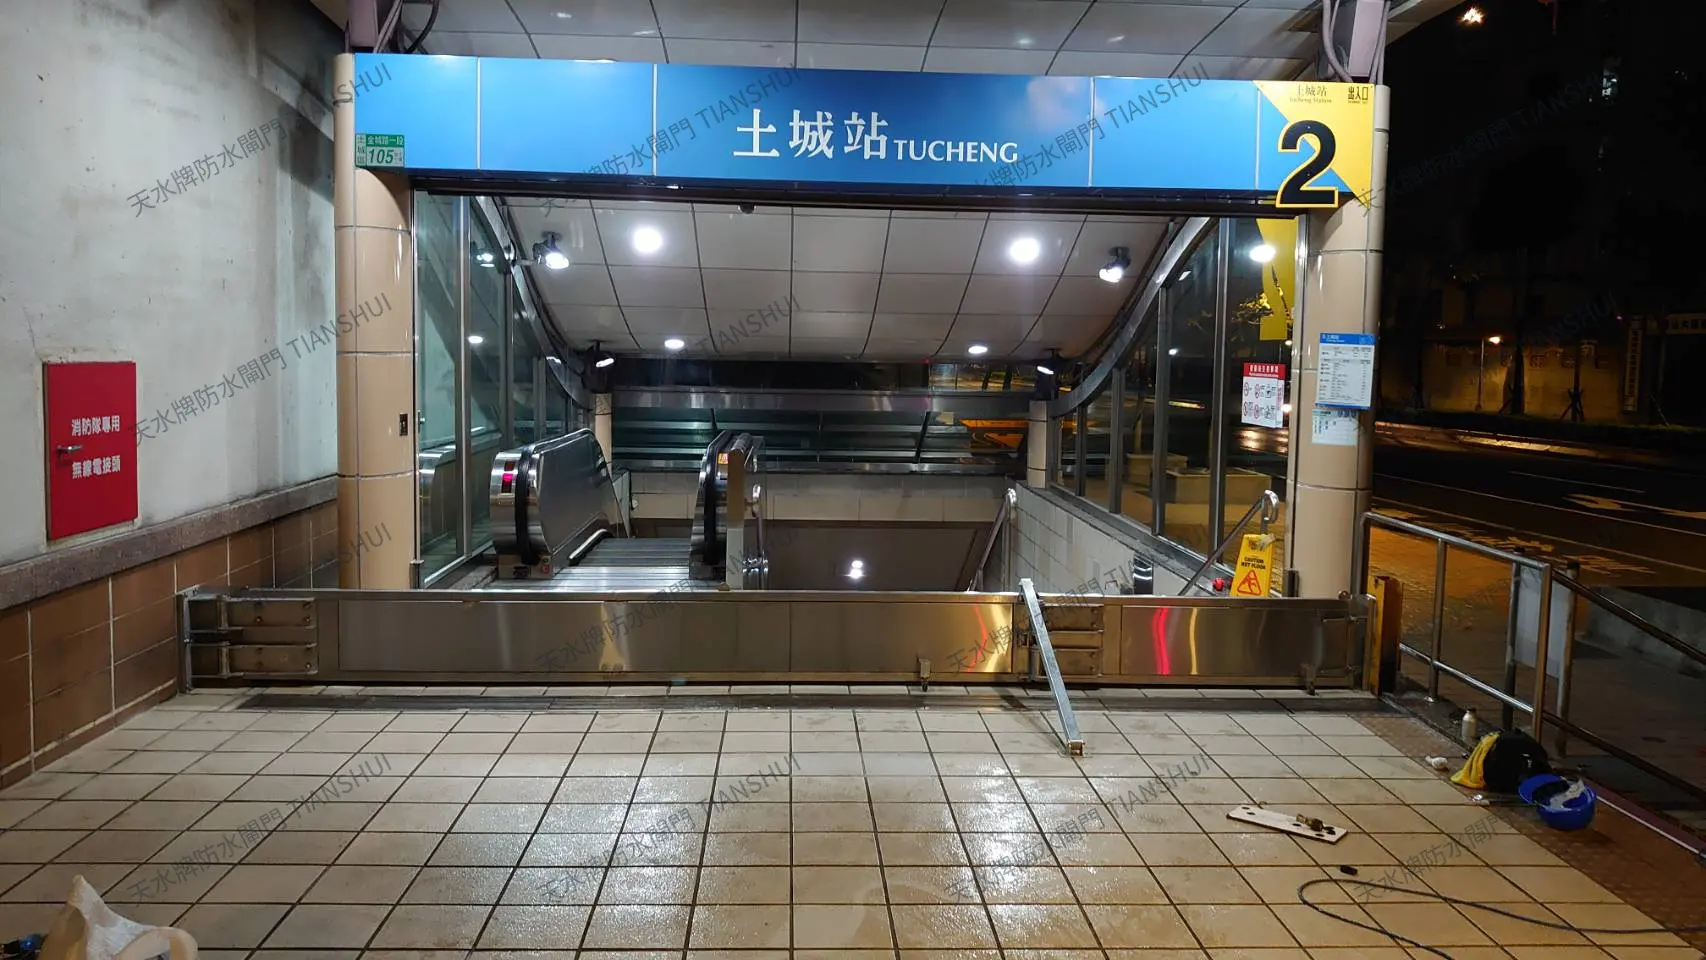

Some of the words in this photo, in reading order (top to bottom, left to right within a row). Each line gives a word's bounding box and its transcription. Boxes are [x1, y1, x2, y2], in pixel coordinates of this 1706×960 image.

[1348, 86, 1368, 100] 出入口
[733, 108, 888, 160] 土城站
[893, 139, 1018, 163] TUCHENG
[369, 148, 394, 165] 105
[1277, 120, 1337, 207] 2
[71, 415, 120, 437] 消防隊專用
[72, 455, 120, 479] 無線電接頭
